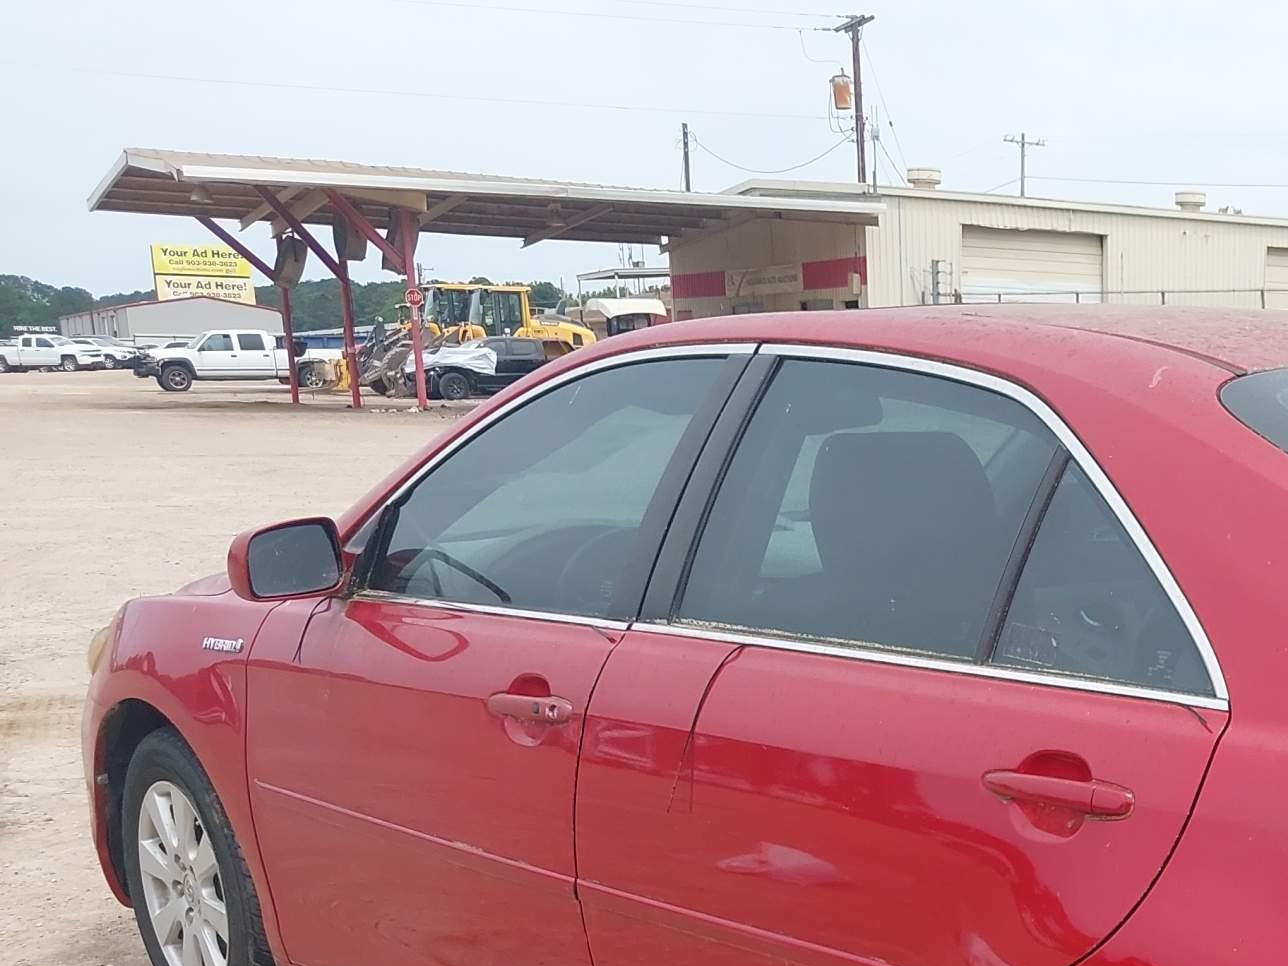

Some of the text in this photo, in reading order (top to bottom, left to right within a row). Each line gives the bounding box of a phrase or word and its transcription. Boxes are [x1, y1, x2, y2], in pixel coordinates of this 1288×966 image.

[161, 248, 188, 257] Your
[192, 249, 208, 258] Ad
[164, 280, 247, 291] Your Ad Here!
[407, 292, 422, 301] STOP
[202, 637, 237, 652] HYBRID
